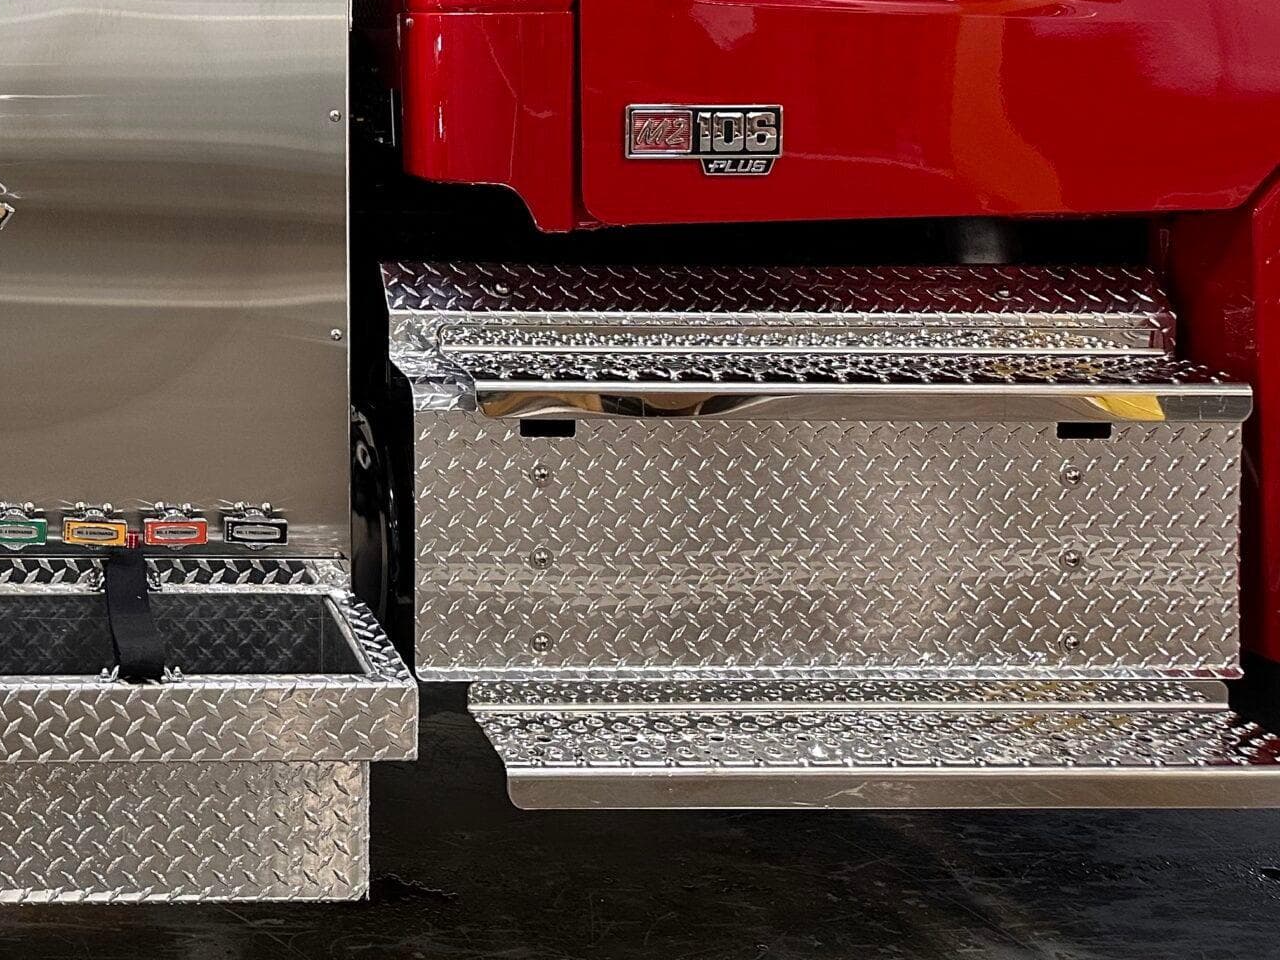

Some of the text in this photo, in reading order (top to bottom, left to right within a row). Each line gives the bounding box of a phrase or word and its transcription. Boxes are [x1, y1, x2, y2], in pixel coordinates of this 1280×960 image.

[636, 111, 777, 152] M2 106
[708, 159, 767, 173] PLUS
